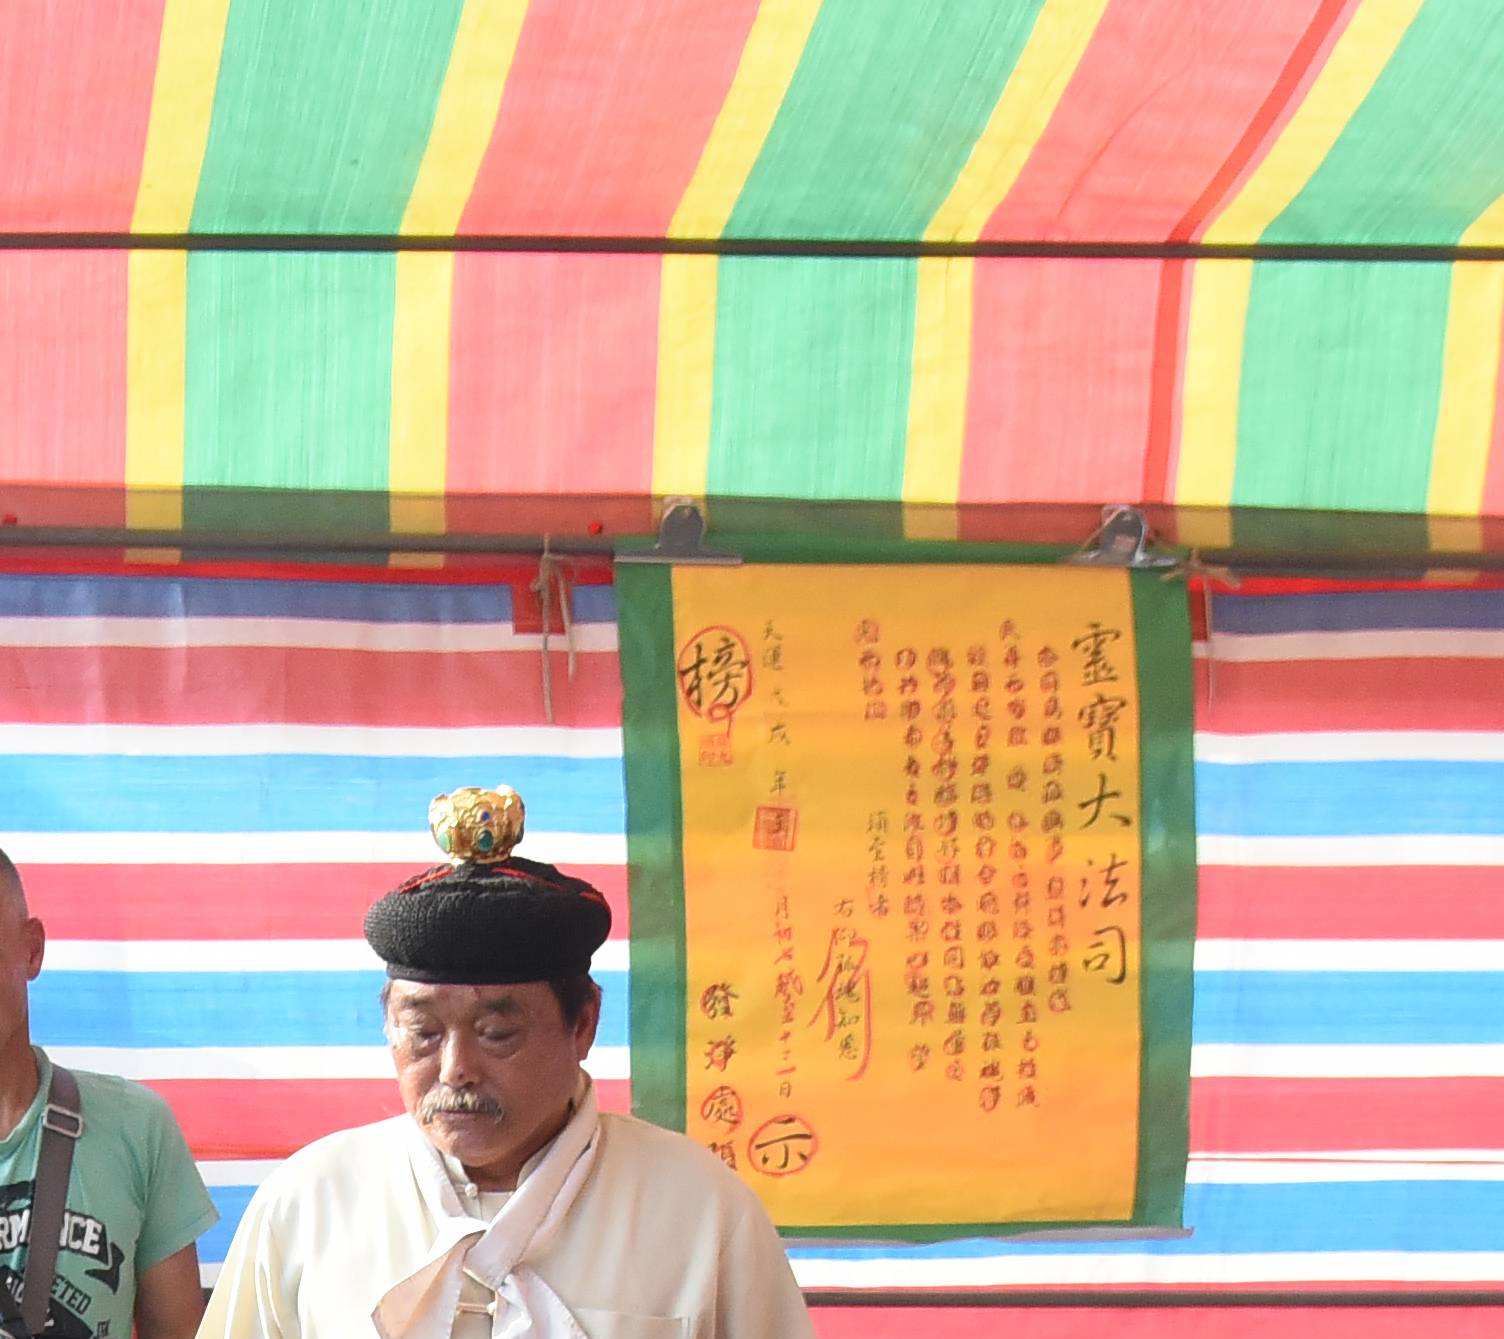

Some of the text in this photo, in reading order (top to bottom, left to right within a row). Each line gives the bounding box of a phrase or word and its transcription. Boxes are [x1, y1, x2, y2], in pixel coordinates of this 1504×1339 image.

[1071, 622, 1132, 985] 靈寶大法司
